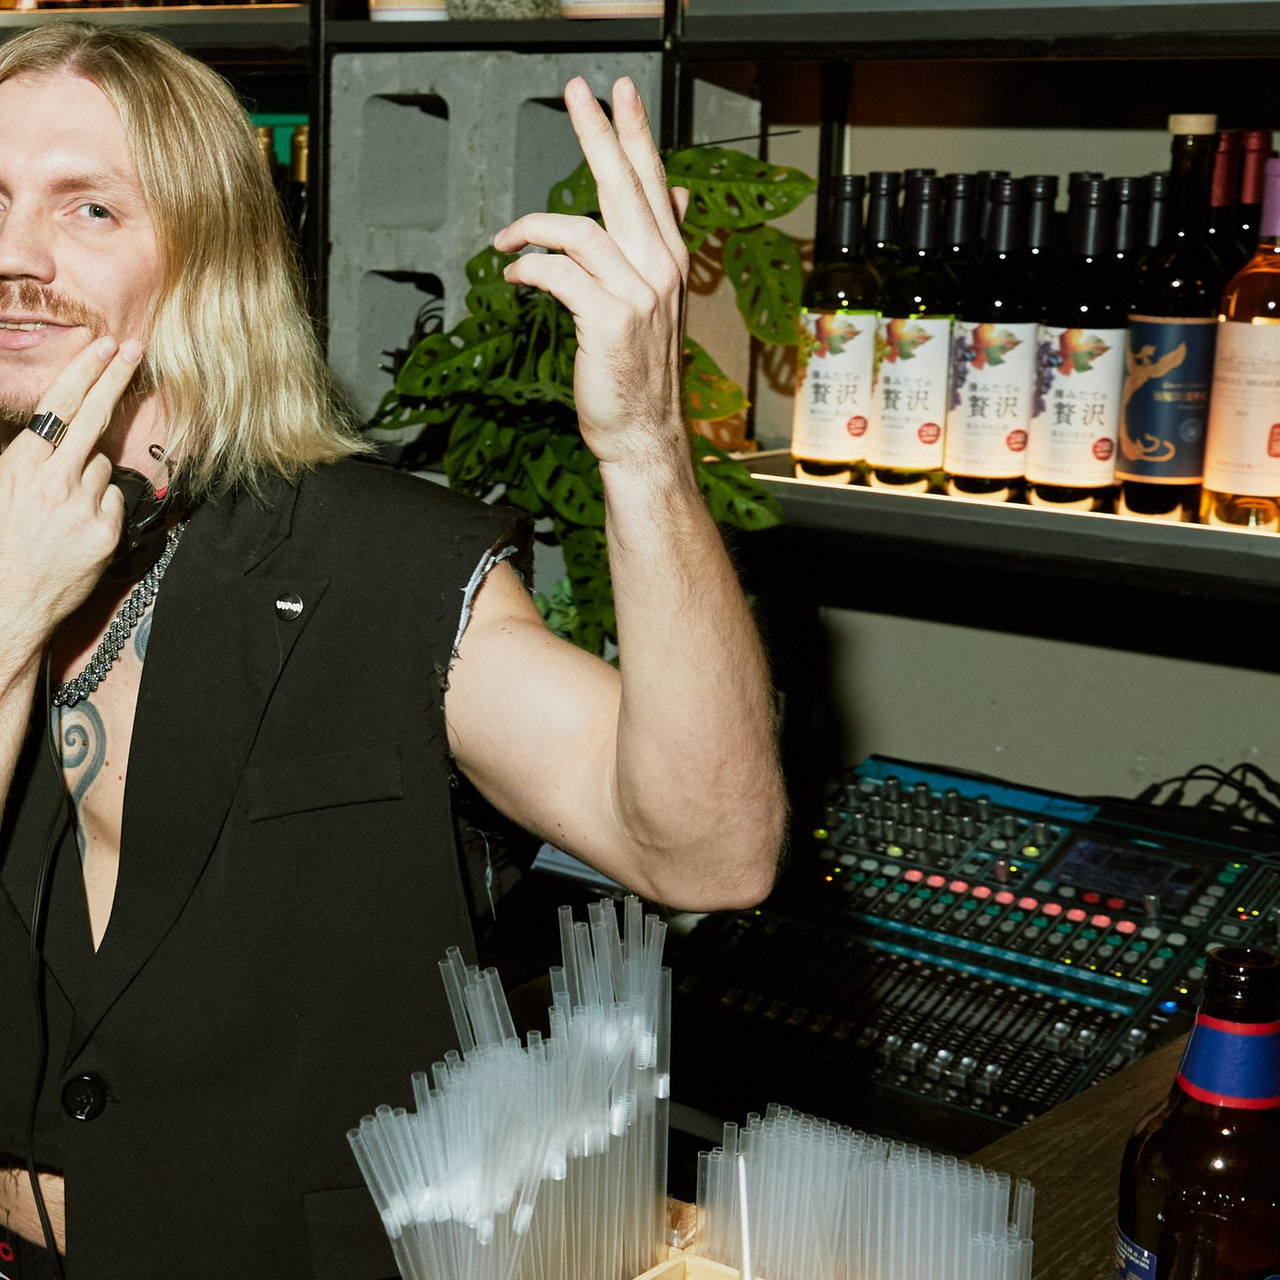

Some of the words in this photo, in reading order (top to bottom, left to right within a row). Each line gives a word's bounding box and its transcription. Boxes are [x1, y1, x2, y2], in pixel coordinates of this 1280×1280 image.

[810, 382, 858, 405] 贅沢
[882, 389, 929, 411] 贅沢
[967, 395, 1019, 418] 贅沢
[1053, 402, 1105, 426] 贅沢
